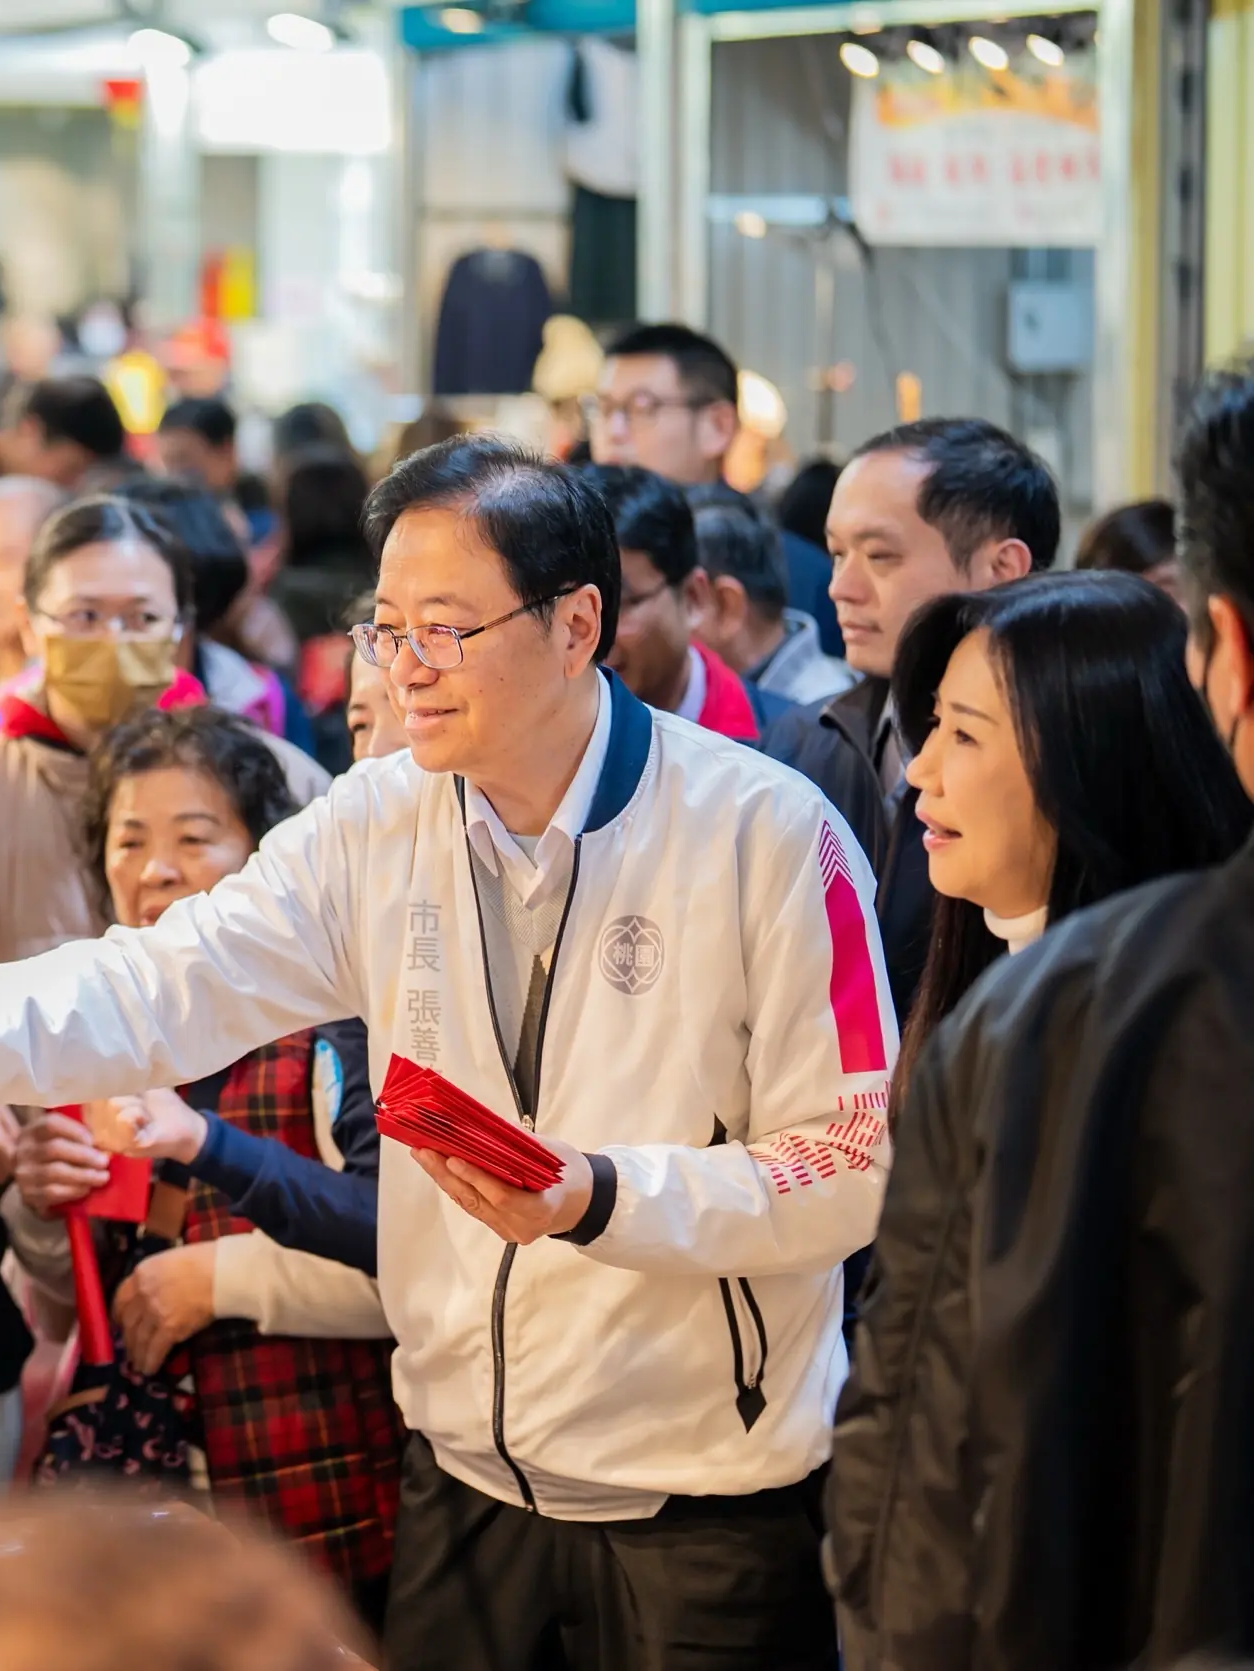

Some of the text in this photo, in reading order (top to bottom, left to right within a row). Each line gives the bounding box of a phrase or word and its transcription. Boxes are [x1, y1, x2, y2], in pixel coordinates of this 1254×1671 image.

[407, 899, 443, 1074] 市長 張善
[612, 941, 655, 967] 桃園
